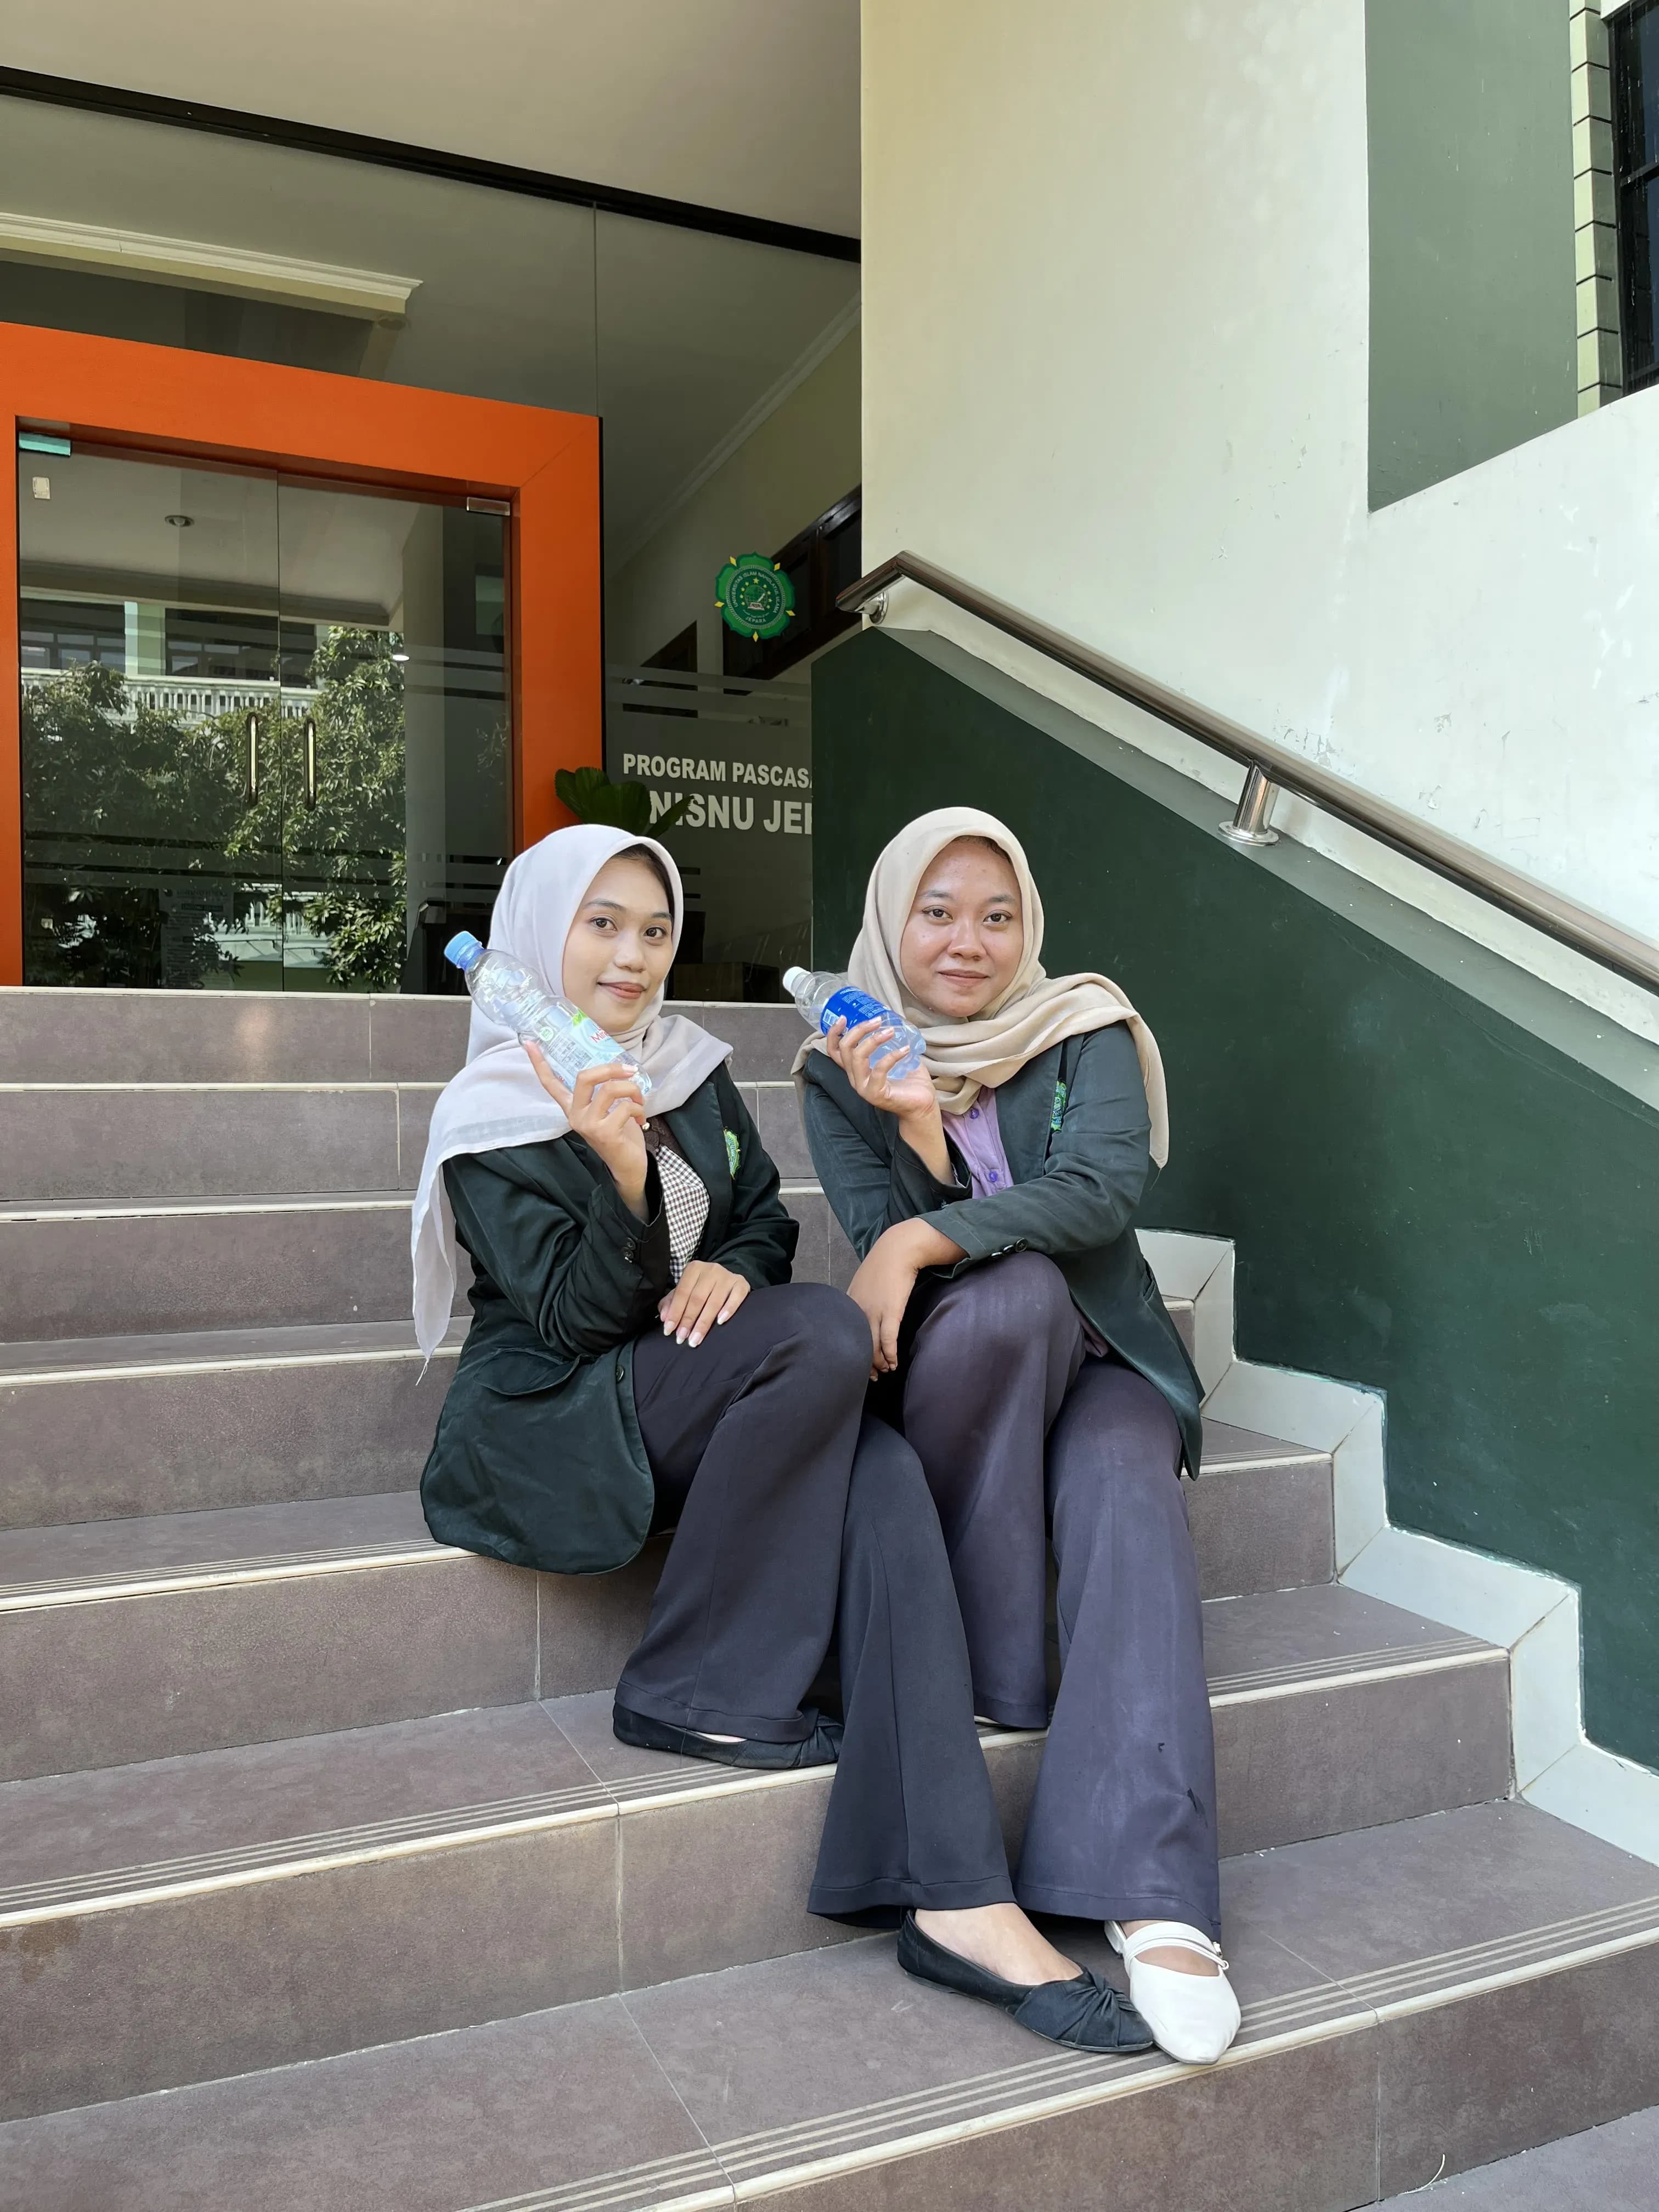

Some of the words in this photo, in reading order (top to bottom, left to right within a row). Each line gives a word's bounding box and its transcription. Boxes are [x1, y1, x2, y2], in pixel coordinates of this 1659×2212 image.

[731, 575, 743, 607] UNIVERSITAS
[772, 596, 781, 613] ULAMA
[623, 753, 726, 781] PROGRAM
[732, 762, 812, 789] PASCAS
